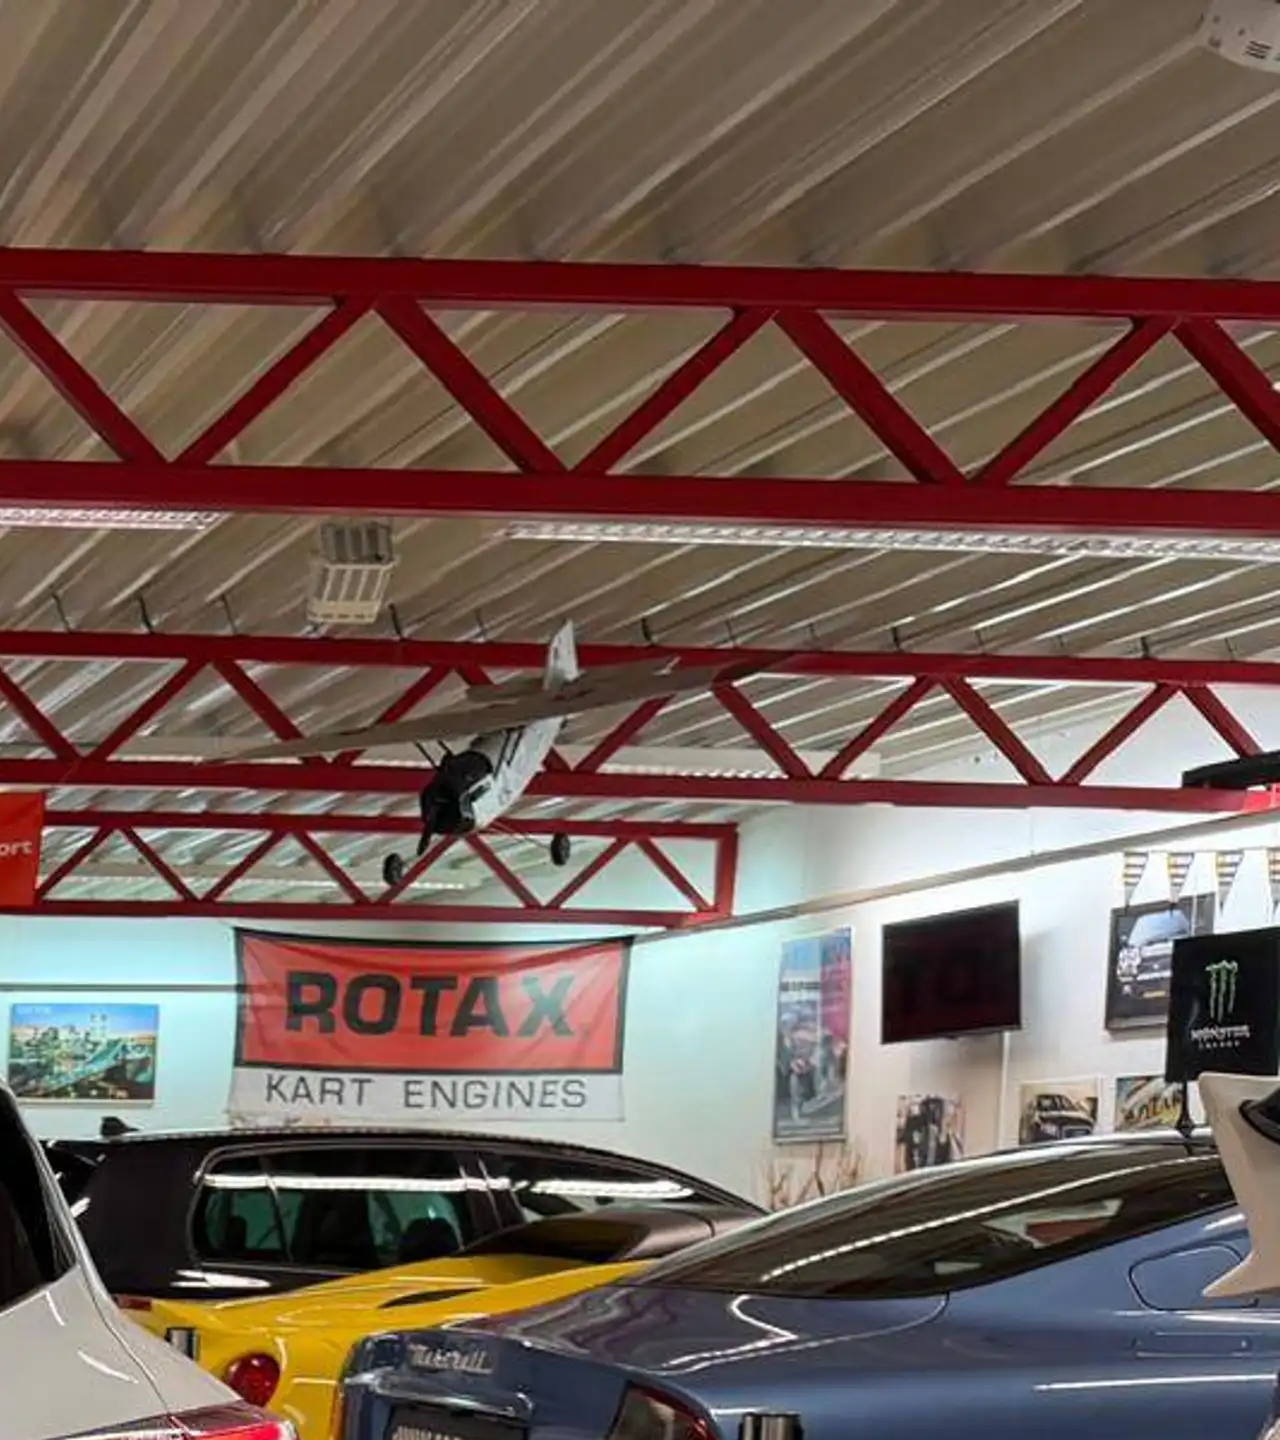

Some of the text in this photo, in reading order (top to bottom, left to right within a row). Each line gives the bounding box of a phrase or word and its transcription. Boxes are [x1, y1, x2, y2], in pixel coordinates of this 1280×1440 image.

[284, 970, 576, 1038] ROTAX
[265, 1073, 588, 1110] KART ENGINES
